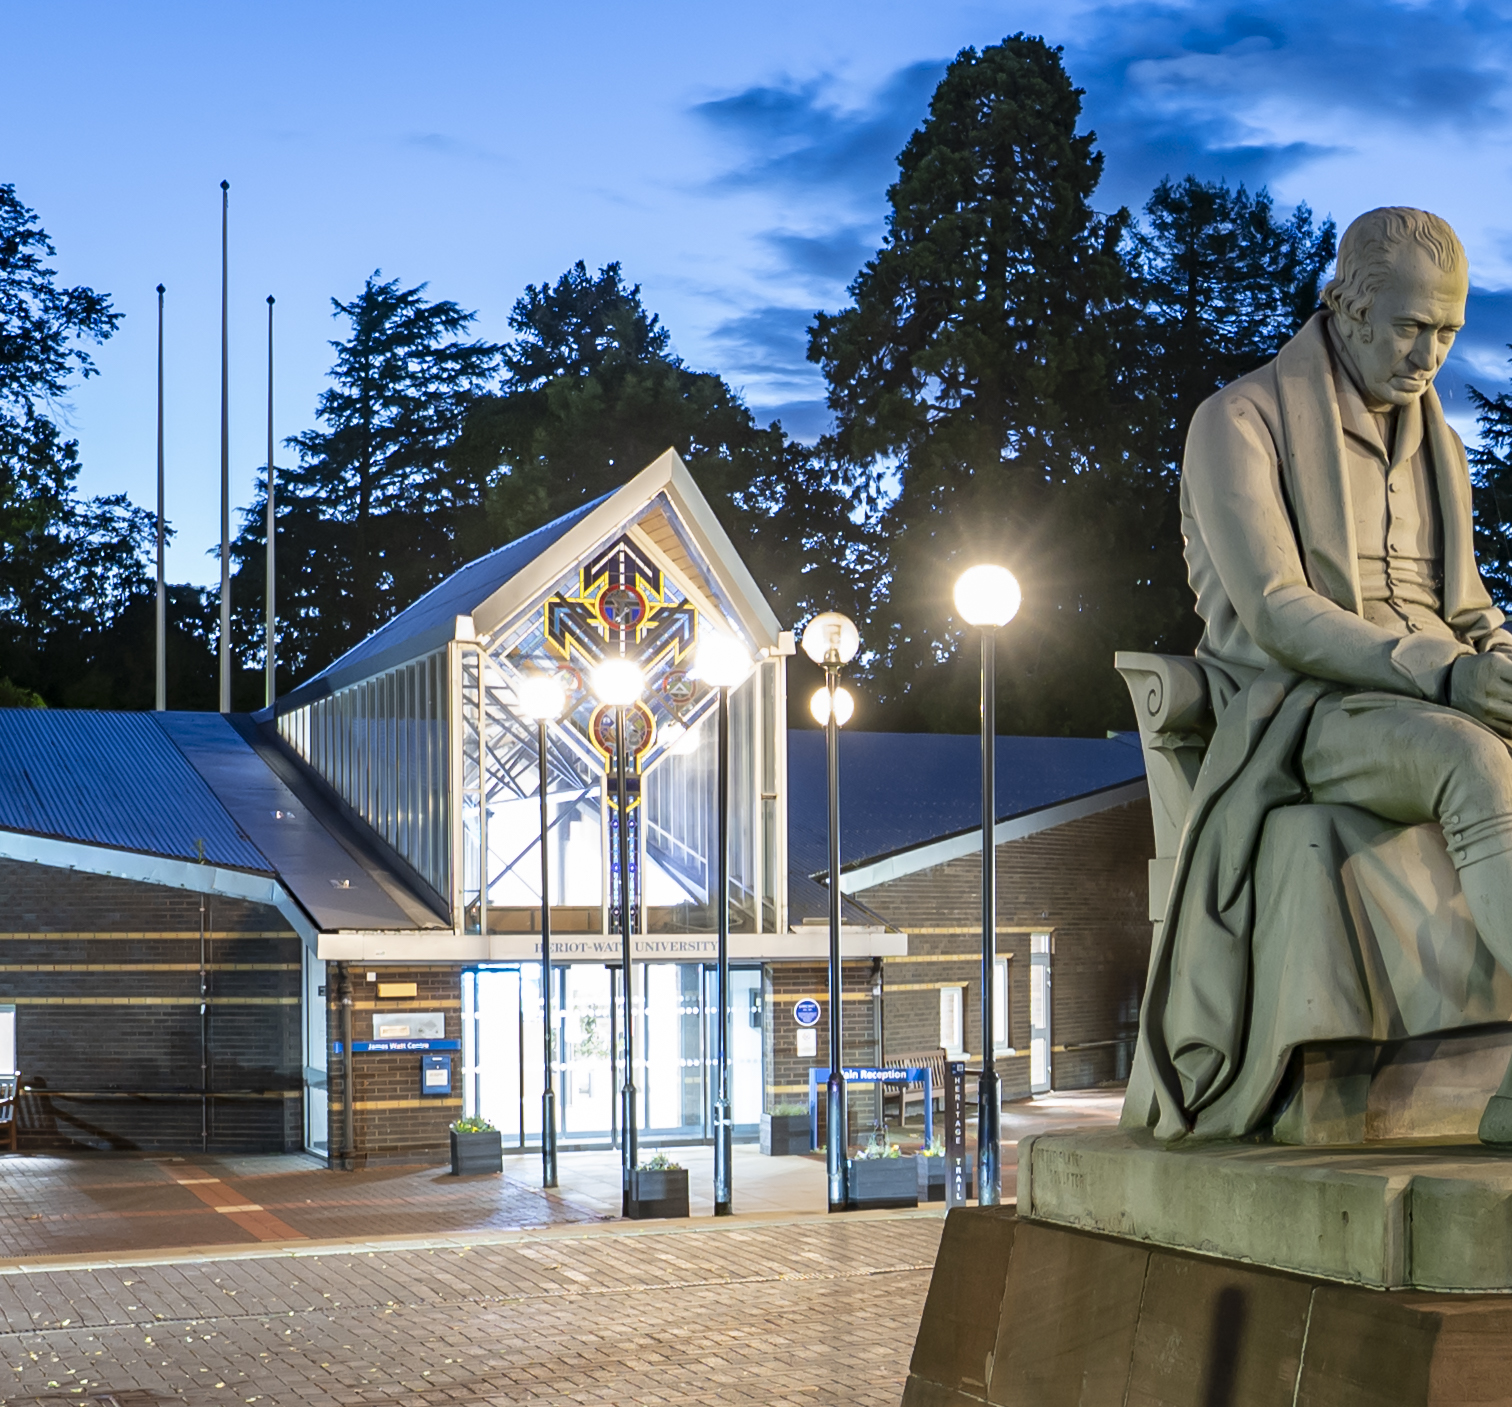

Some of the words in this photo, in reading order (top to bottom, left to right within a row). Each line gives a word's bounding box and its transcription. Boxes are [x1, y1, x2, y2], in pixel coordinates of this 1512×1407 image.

[534, 942, 624, 953] HERIOT-WAT
[634, 941, 719, 952] UNIVERSITY
[389, 1042, 406, 1050] Watt
[407, 1042, 429, 1050] Centre
[841, 1069, 858, 1079] ain
[860, 1069, 907, 1081] Reception
[954, 1077, 962, 1144] HERITAGE
